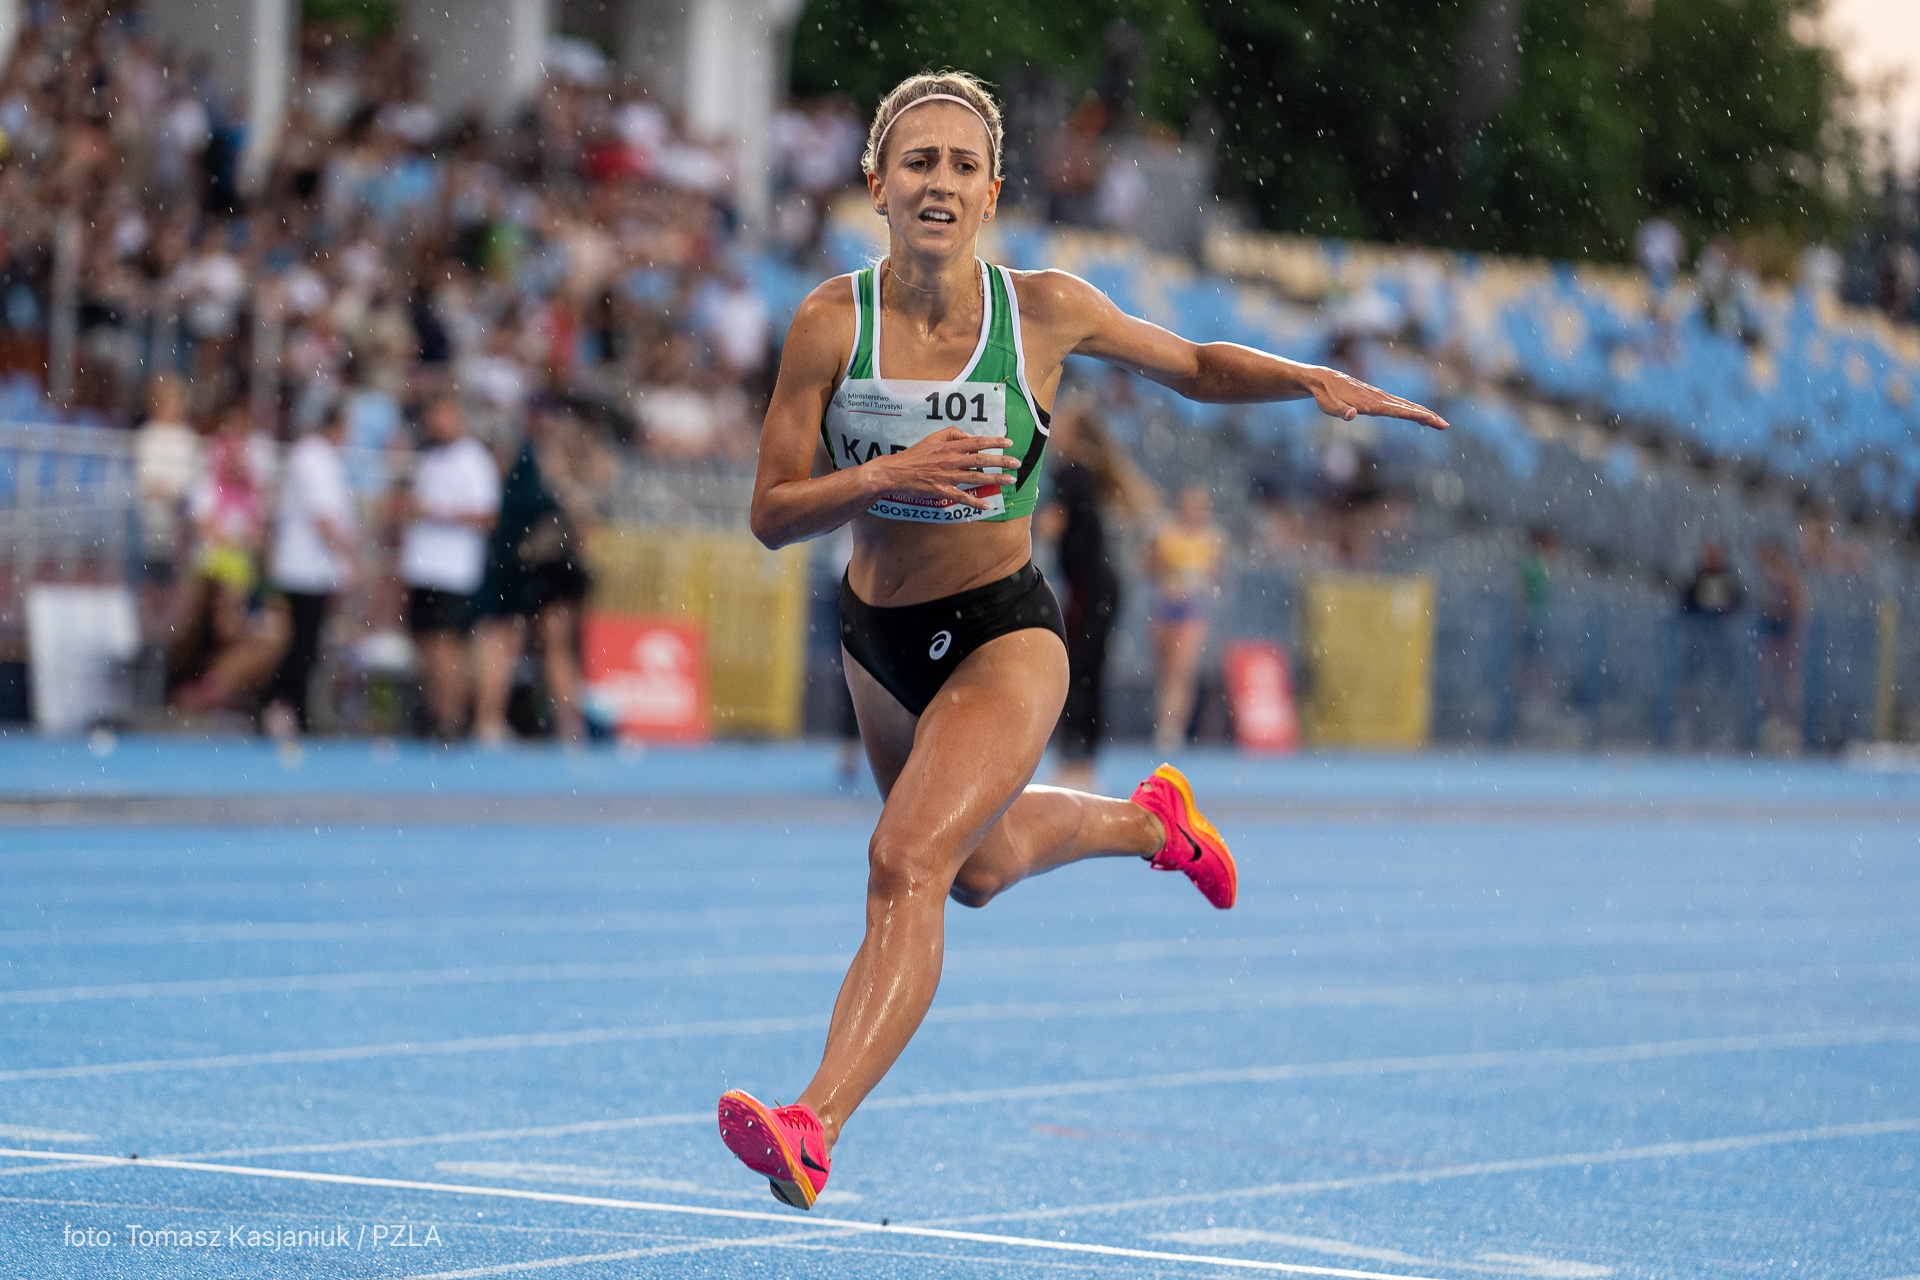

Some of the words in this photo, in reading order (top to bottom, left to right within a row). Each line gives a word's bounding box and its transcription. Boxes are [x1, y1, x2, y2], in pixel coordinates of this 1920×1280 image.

[847, 393, 889, 402] Ministerstwo
[847, 400, 870, 408] Sportu
[873, 402, 903, 411] Turystyki
[925, 391, 988, 422] 101
[893, 494, 948, 506] Mistrzostwa
[871, 503, 941, 520] DGOSZCZ
[944, 507, 983, 520] 2024
